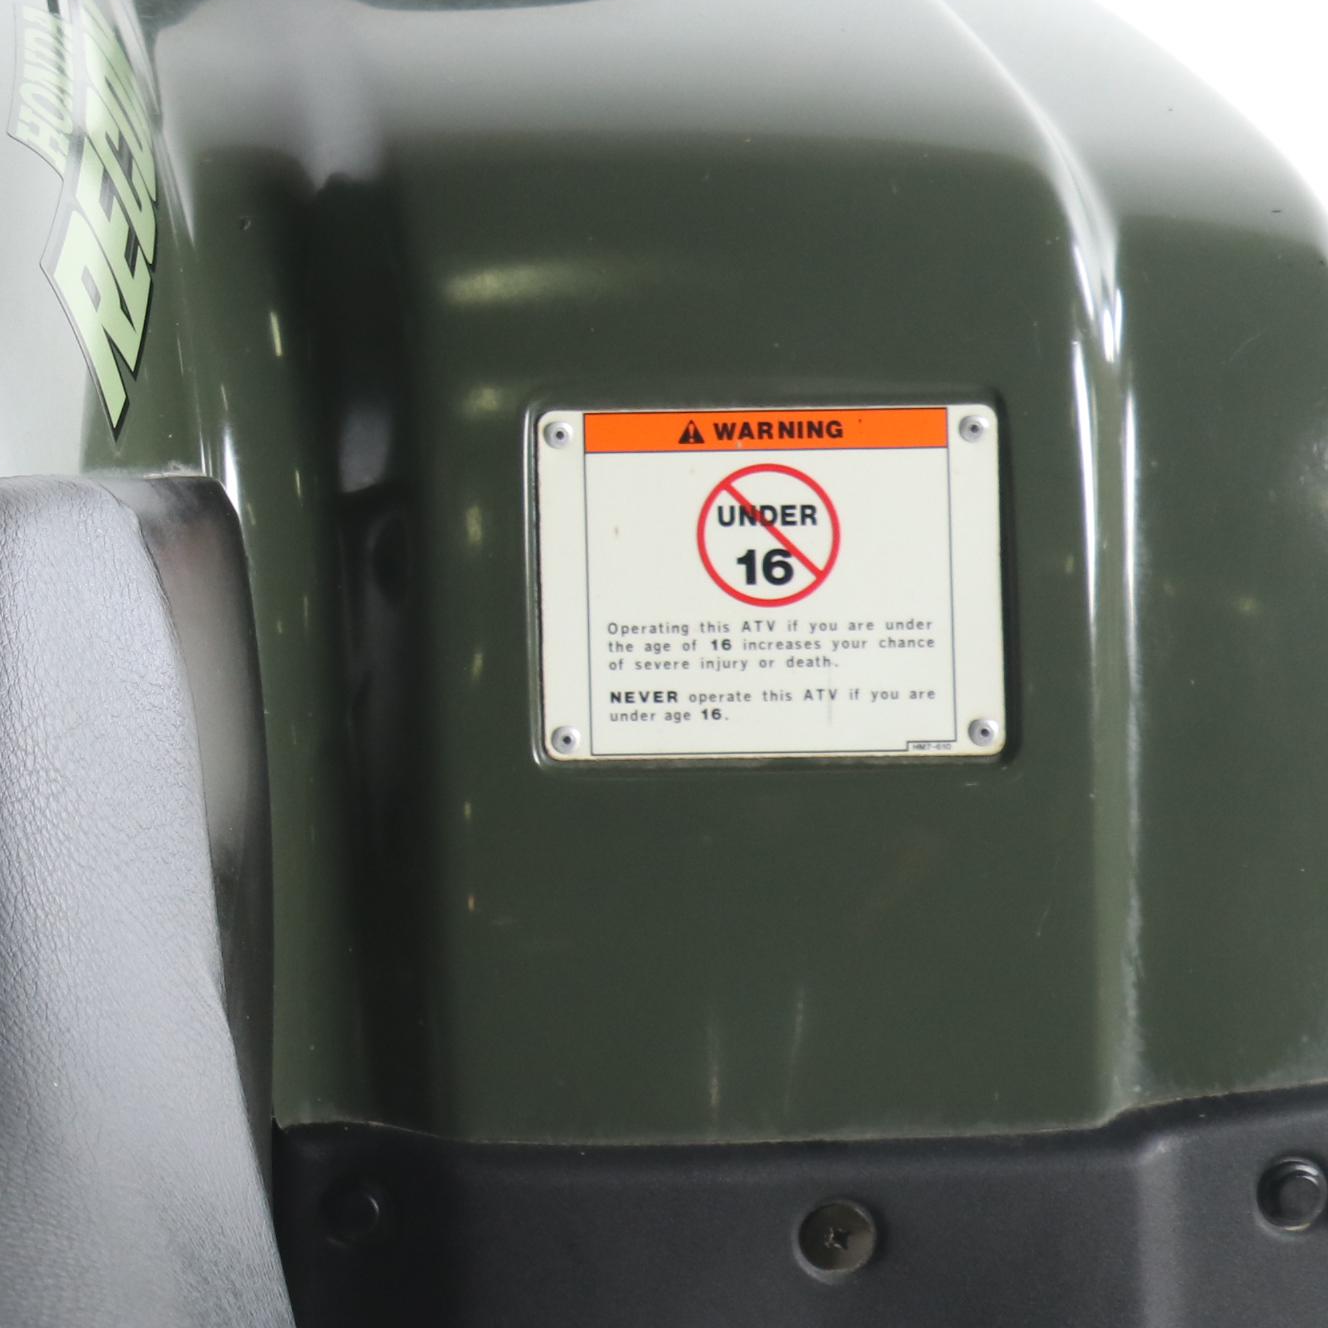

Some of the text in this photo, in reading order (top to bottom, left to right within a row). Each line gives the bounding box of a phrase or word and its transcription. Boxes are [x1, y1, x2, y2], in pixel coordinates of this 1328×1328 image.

[713, 420, 844, 440] WARNING
[717, 504, 817, 527] UNDER
[736, 549, 794, 586] 16
[607, 618, 932, 637] Operating this ATV if you are under
[607, 636, 934, 654] the age of 16 increases your chance
[608, 655, 837, 672] of severe injury or death.
[609, 688, 935, 705] NEVER operate this ATV if you are
[609, 707, 728, 723] under age 16.
